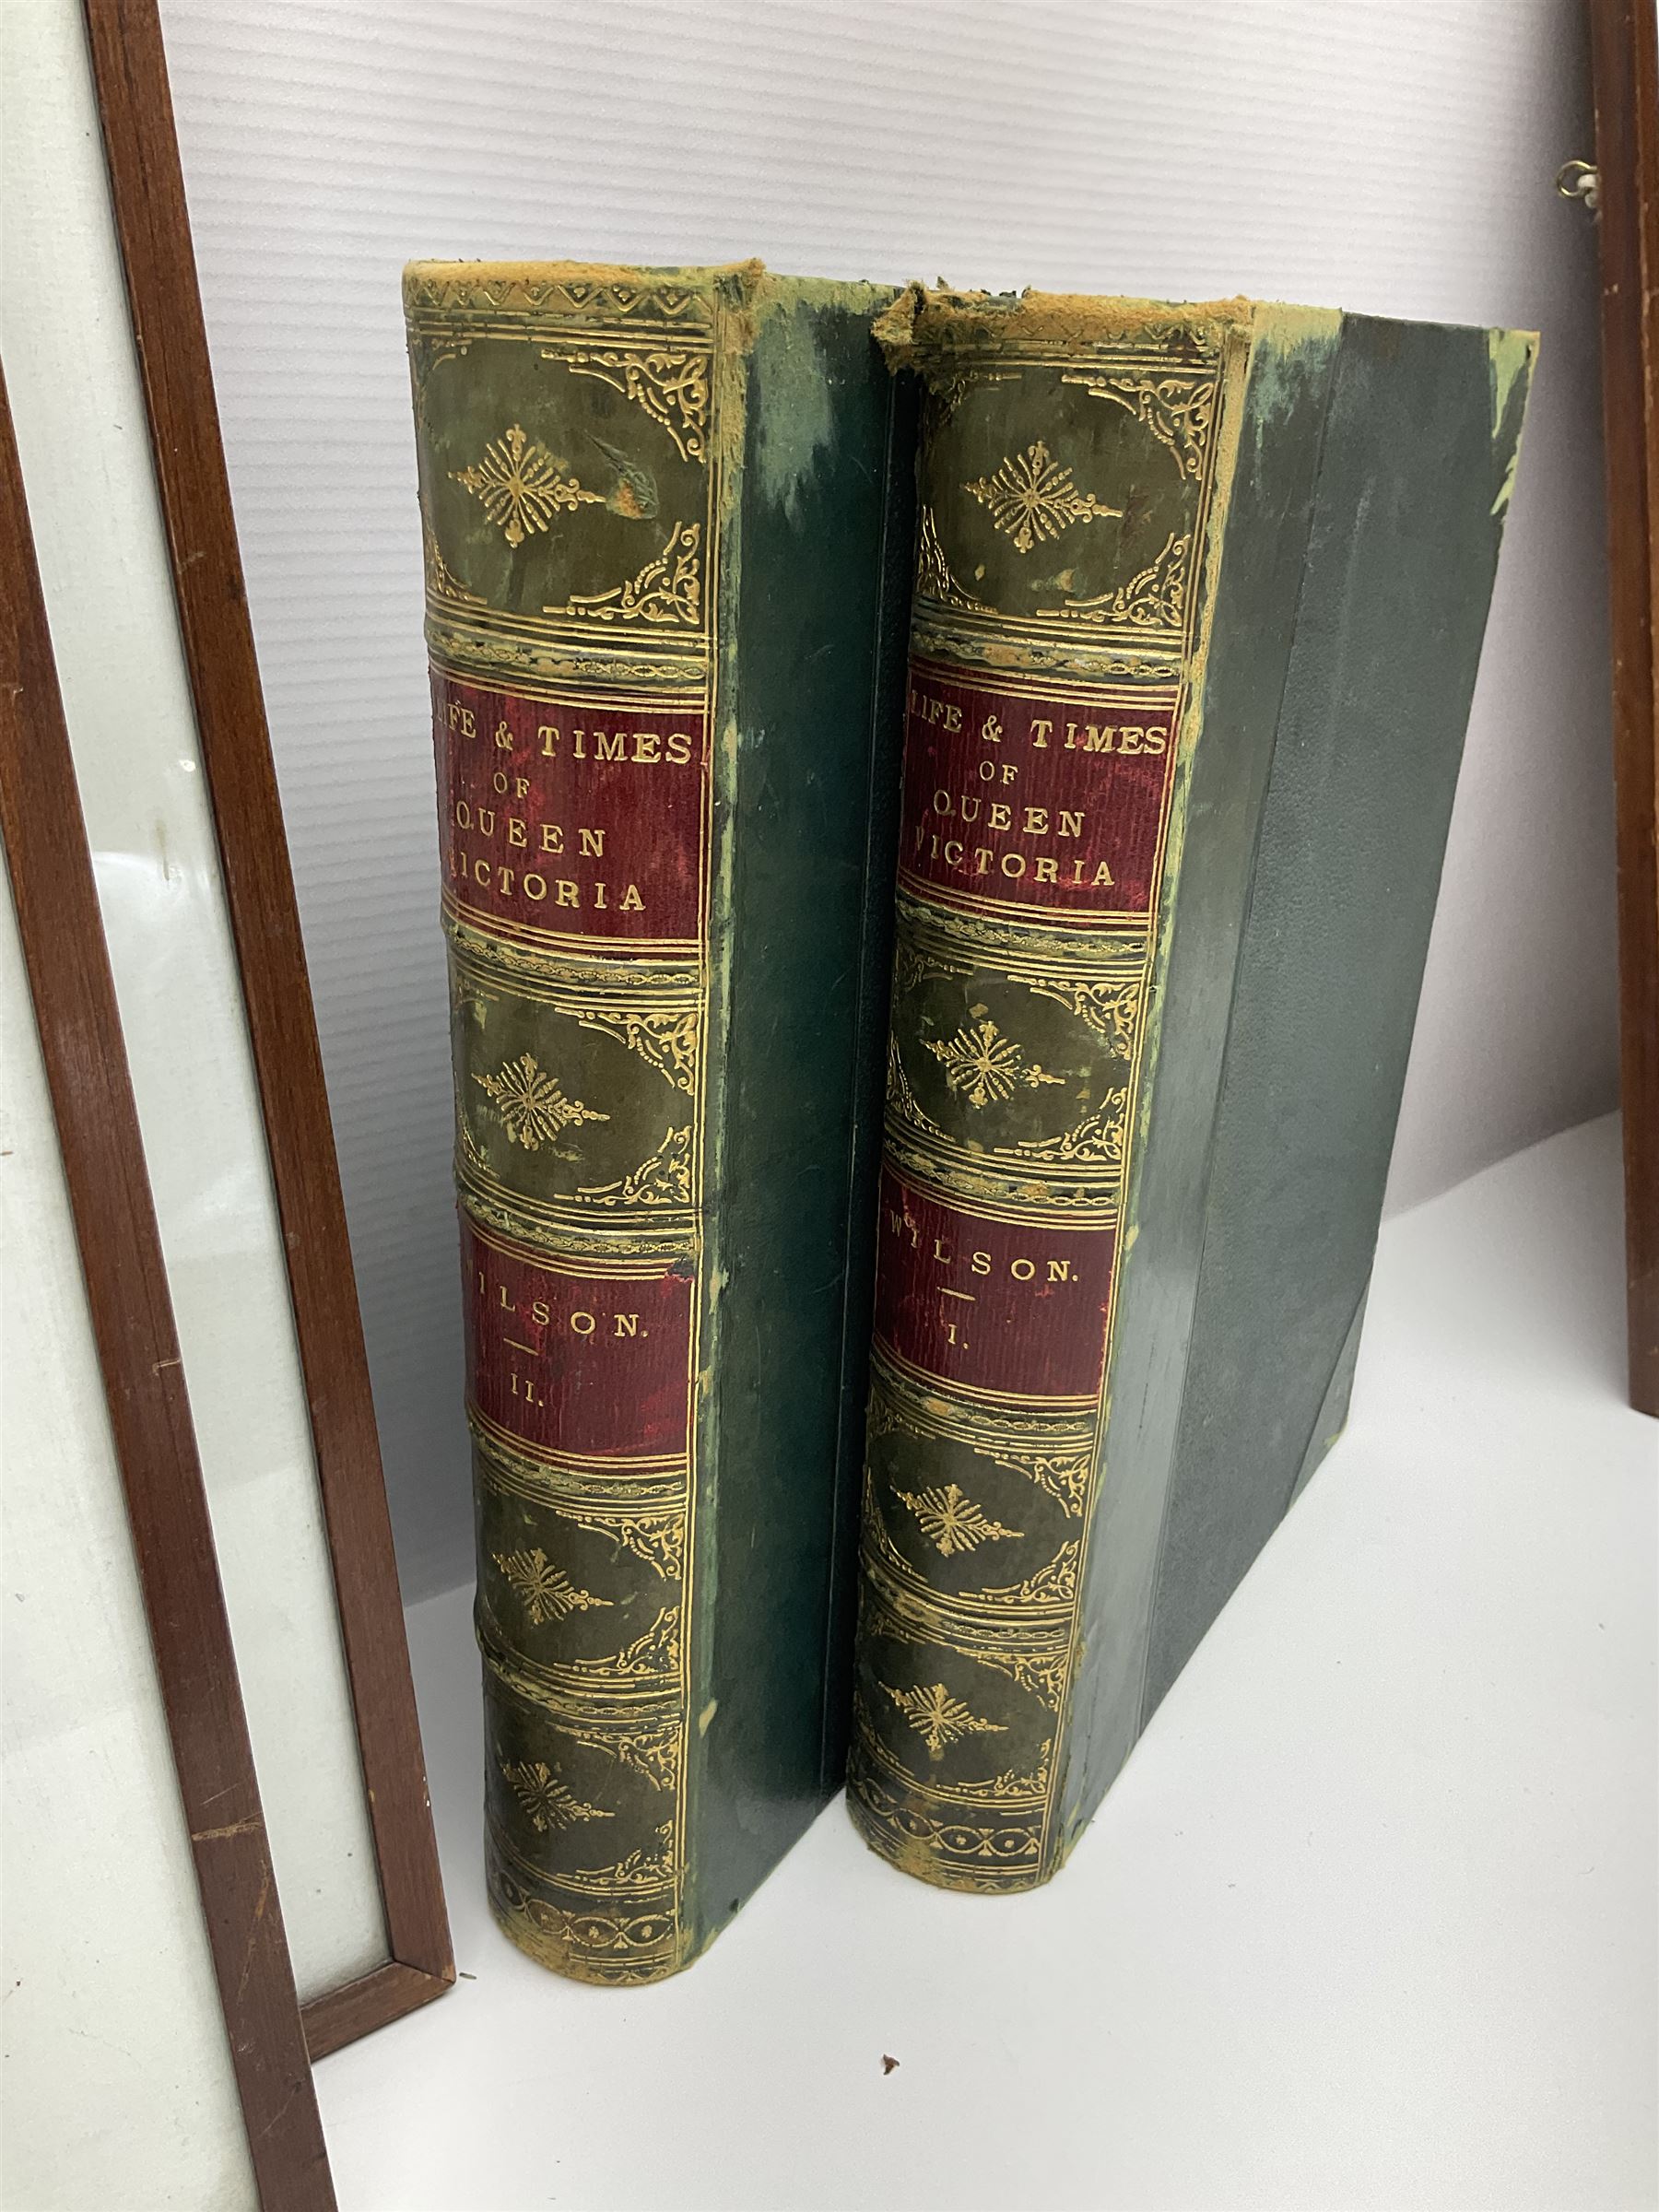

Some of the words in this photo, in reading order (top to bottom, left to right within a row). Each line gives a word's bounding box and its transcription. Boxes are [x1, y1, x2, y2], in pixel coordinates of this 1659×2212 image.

[495, 721, 513, 751] &
[537, 725, 692, 764] TIMES
[910, 689, 962, 734] LIFE
[982, 715, 1004, 743] &
[1030, 719, 1168, 755] TIMES
[493, 772, 531, 799] OF
[979, 760, 1018, 785] OF
[456, 800, 606, 857] QUEEN
[933, 789, 1086, 838] QUEEN
[915, 826, 1115, 886] VICTORIA
[889, 1209, 1079, 1282] WILSON.
[466, 1259, 648, 1337] ILSON.
[947, 1323, 970, 1350] I.
[510, 1371, 545, 1407] II.
